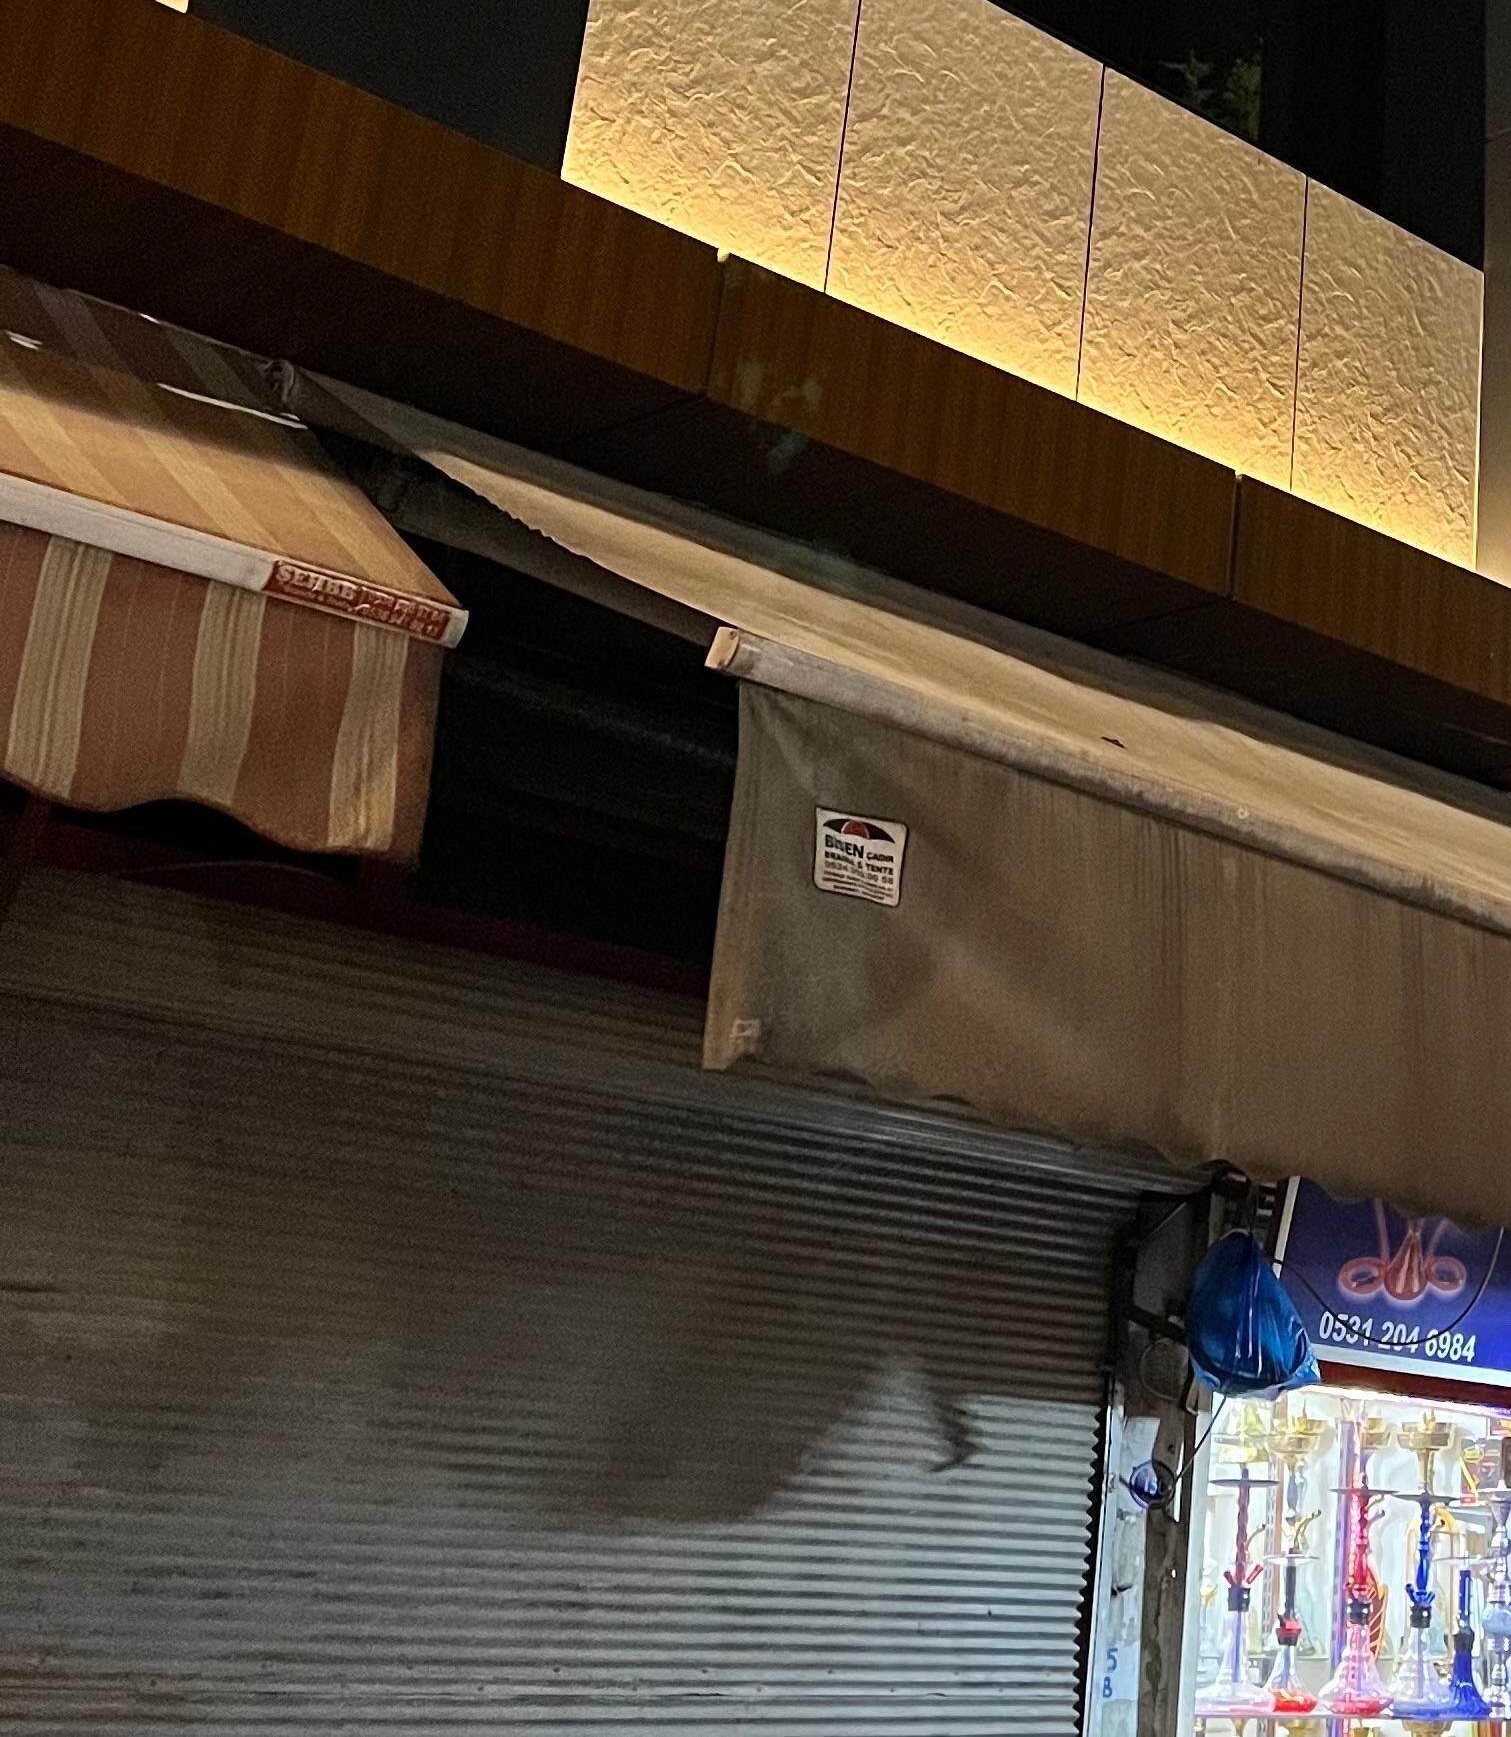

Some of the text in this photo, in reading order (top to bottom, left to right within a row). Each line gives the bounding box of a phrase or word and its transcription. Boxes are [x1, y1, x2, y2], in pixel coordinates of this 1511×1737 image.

[1319, 1311, 1477, 1362] 0531 204 6984
